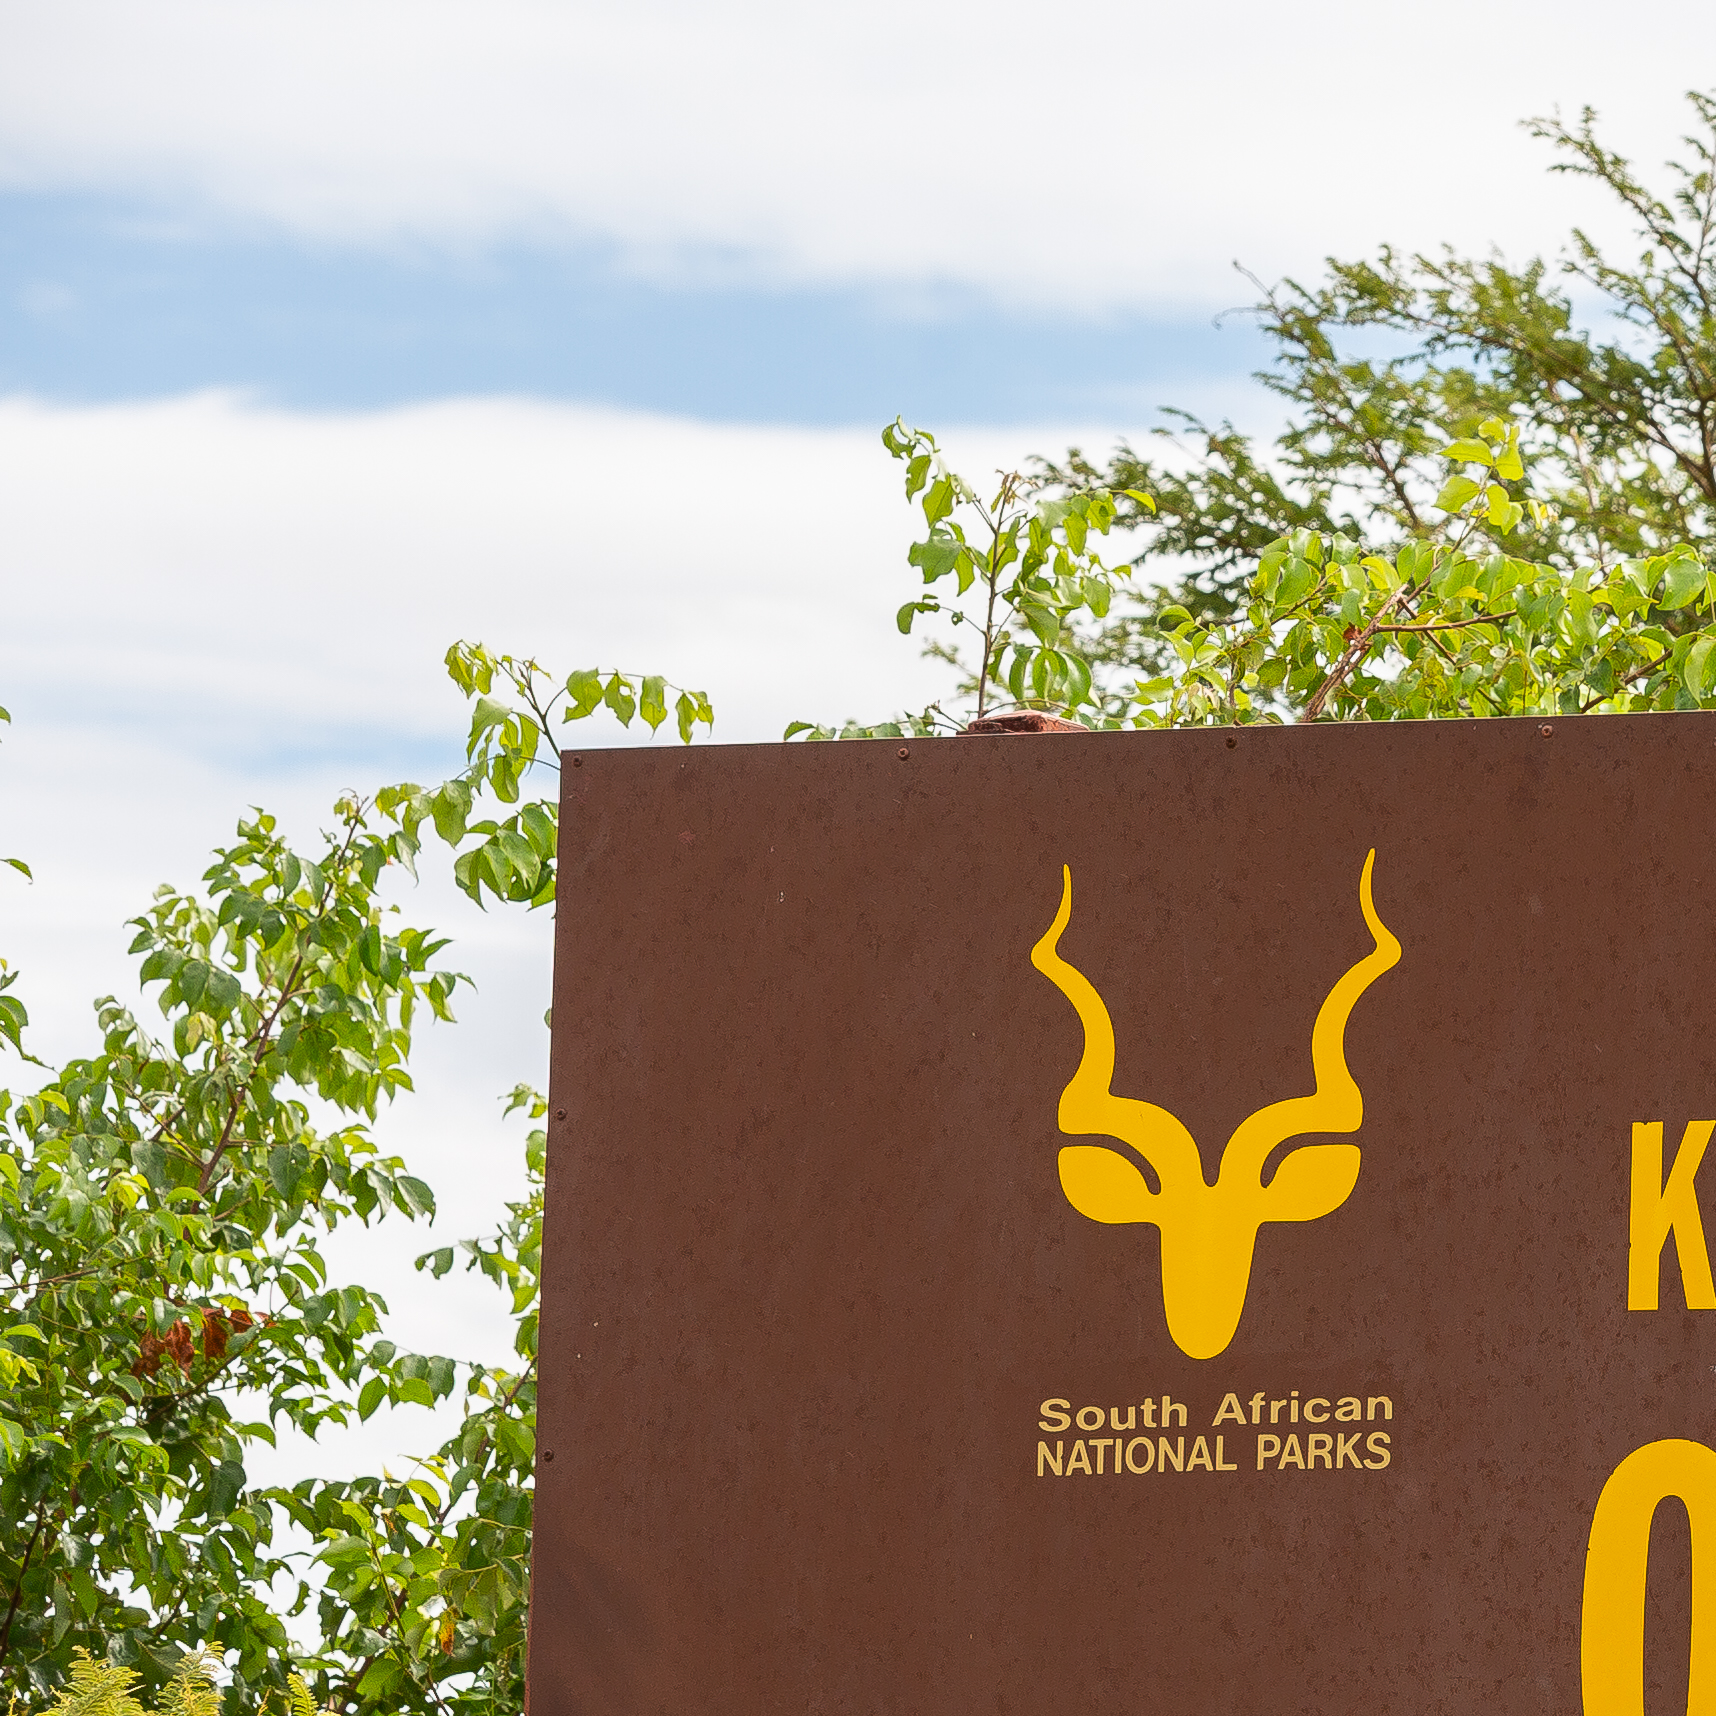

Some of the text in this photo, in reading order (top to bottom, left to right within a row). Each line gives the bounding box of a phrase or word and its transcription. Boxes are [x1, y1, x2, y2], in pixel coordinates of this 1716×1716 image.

[1037, 1390, 1393, 1432] South African
[1036, 1431, 1392, 1477] NATIONAL PARKS
